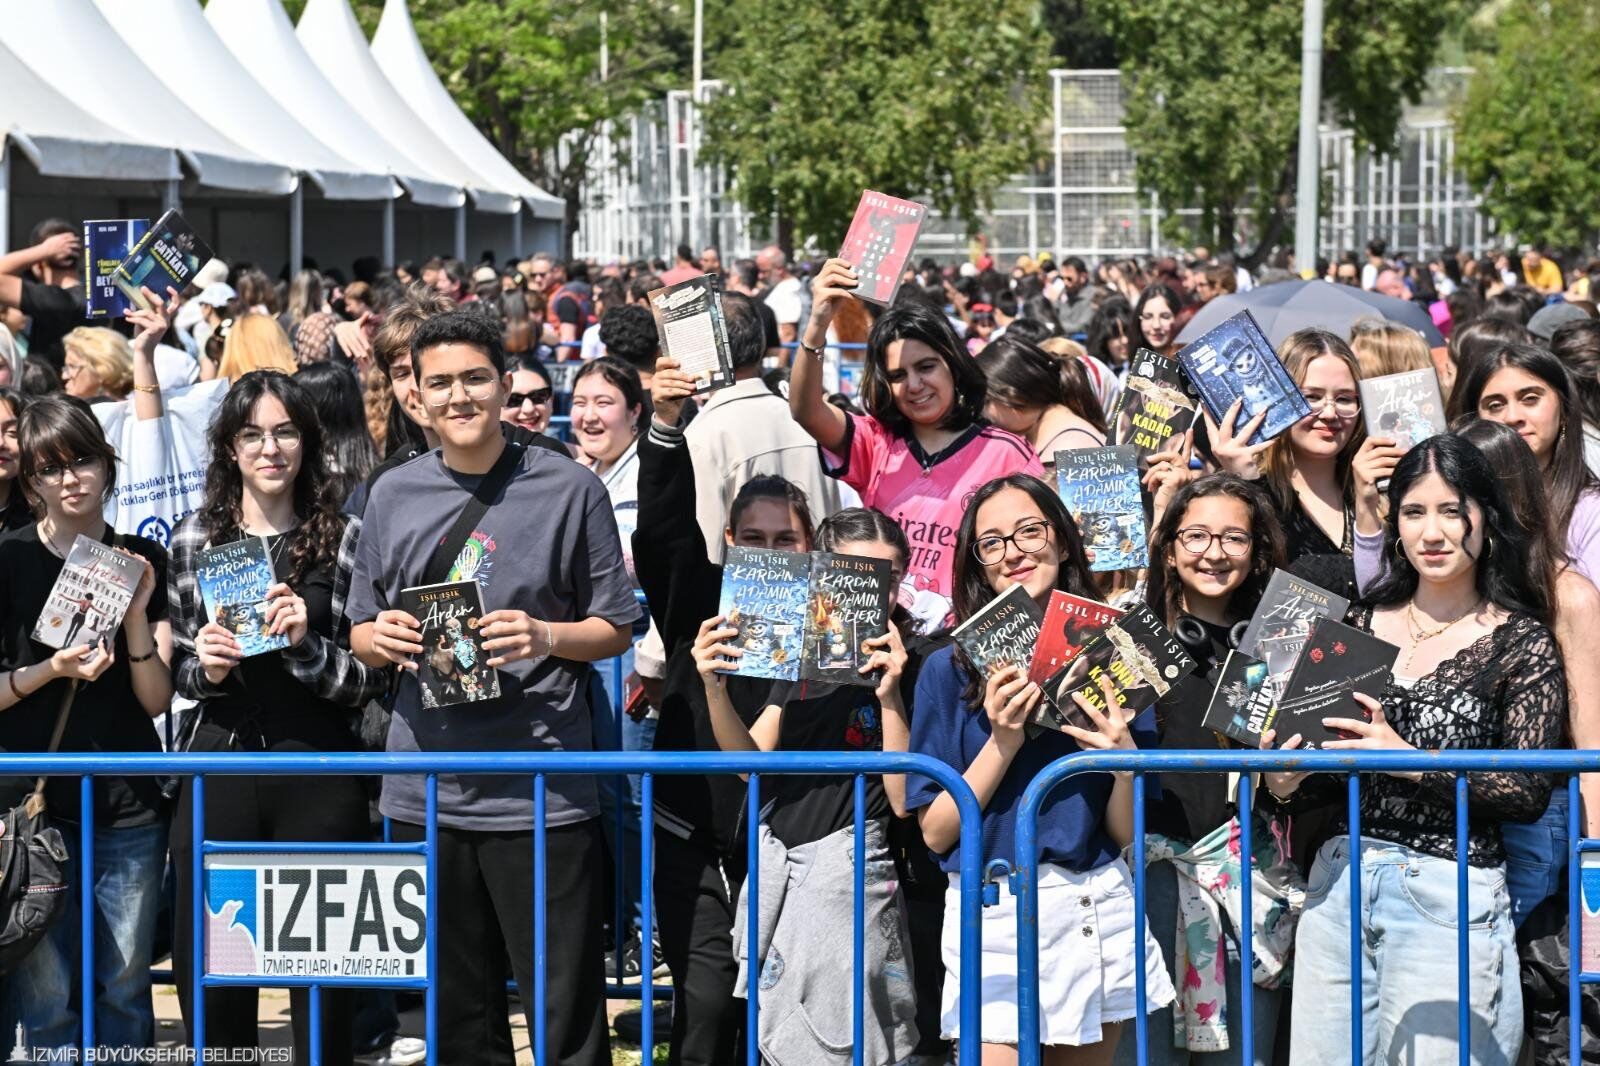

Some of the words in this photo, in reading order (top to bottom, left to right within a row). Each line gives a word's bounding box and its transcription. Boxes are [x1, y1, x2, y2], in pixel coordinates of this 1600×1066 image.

[1146, 400, 1170, 420] ONA
[1132, 413, 1172, 437] KADAR
[1135, 432, 1159, 450] SAY
[1066, 464, 1124, 484] KARDAN
[1073, 480, 1127, 501] ADAMIN
[205, 557, 255, 582] KARDAN
[732, 566, 794, 586] KARDAN
[214, 571, 259, 598] ADAMIN
[818, 572, 879, 592] KARDAN
[737, 586, 792, 601] ADAMIN
[824, 590, 880, 607] ADAMIN
[421, 602, 474, 636] Arden
[1060, 602, 1087, 618] IŞIL
[1095, 612, 1119, 625] IŞI
[977, 608, 1030, 659] KARDAN
[995, 621, 1040, 667] ADAMIN
[1139, 608, 1160, 637] IŞIL
[1164, 638, 1191, 668] IŞIK
[1110, 660, 1136, 688] ONA
[297, 959, 330, 975] FUARI
[374, 959, 400, 975] FAIR
